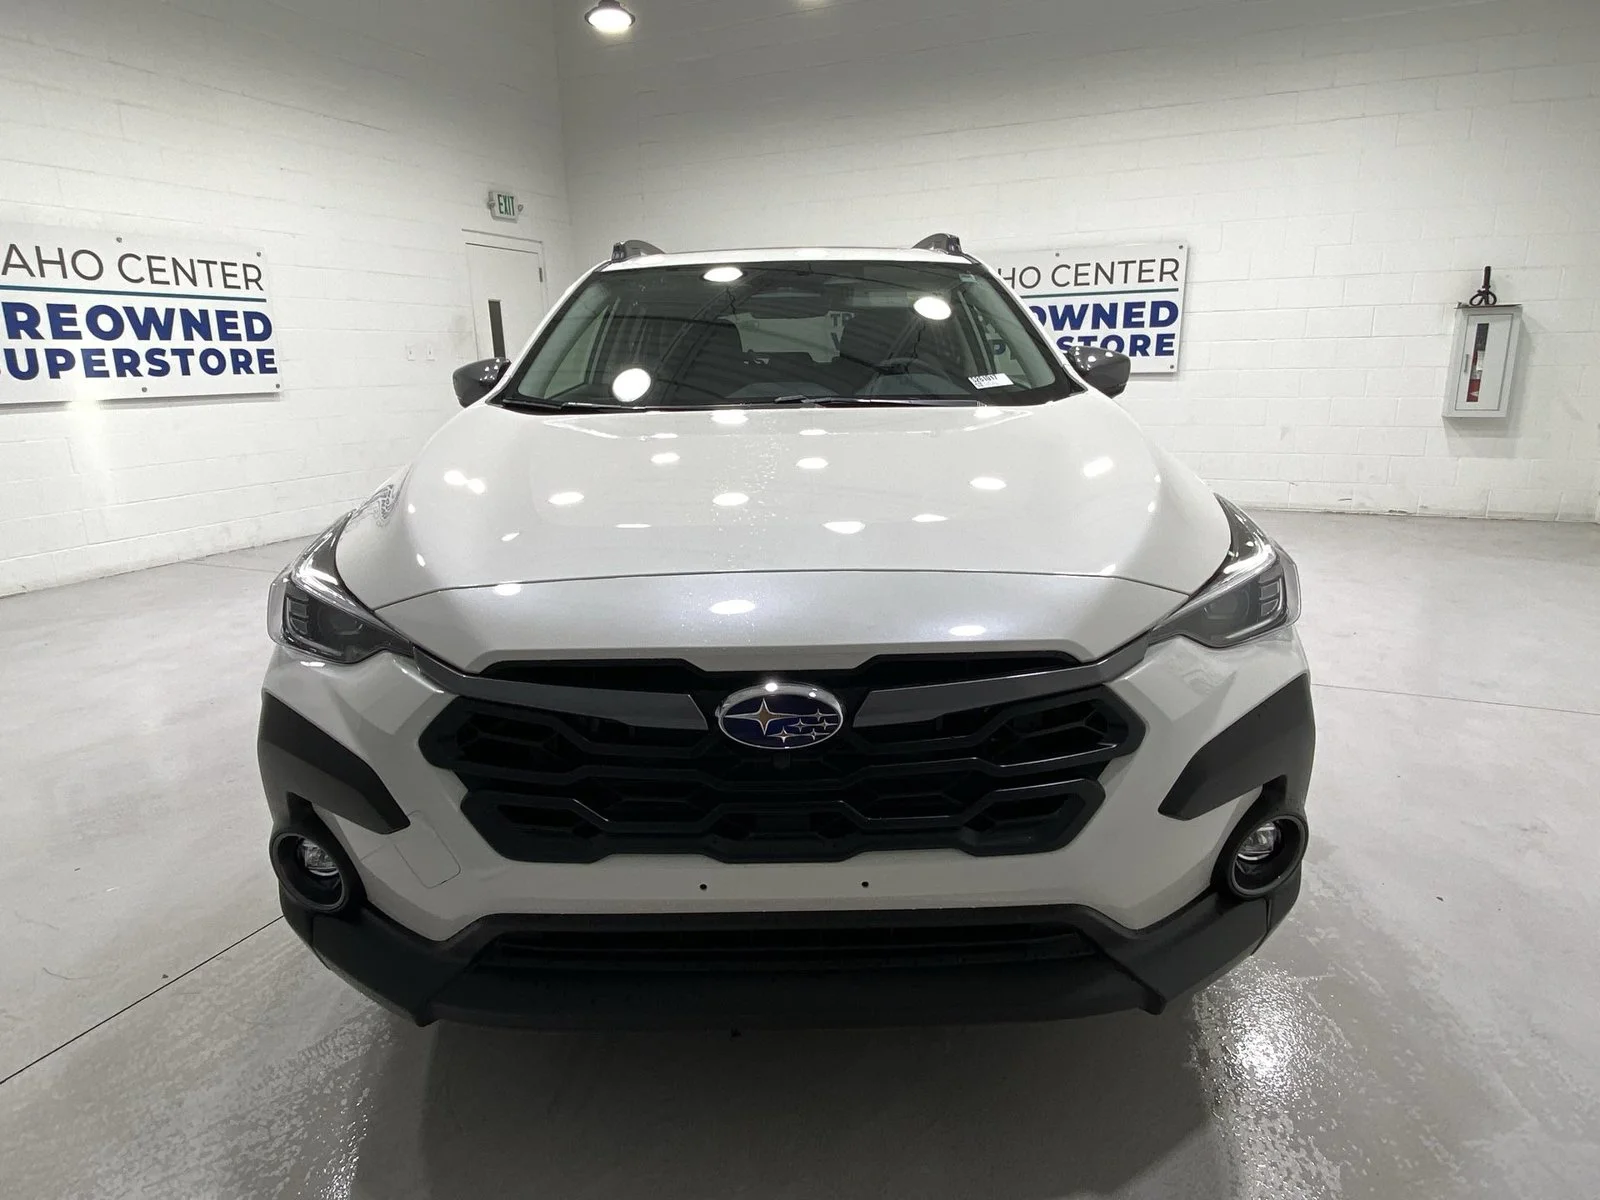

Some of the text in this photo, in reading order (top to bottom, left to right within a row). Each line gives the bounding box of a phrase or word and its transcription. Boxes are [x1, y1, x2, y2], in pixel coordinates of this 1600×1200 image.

[497, 194, 515, 216] EXIT
[1, 243, 265, 291] AHO CENTER
[1051, 257, 1180, 288] CENTER
[1, 301, 273, 342] REOWNED
[0, 347, 279, 381] UPERSTORE
